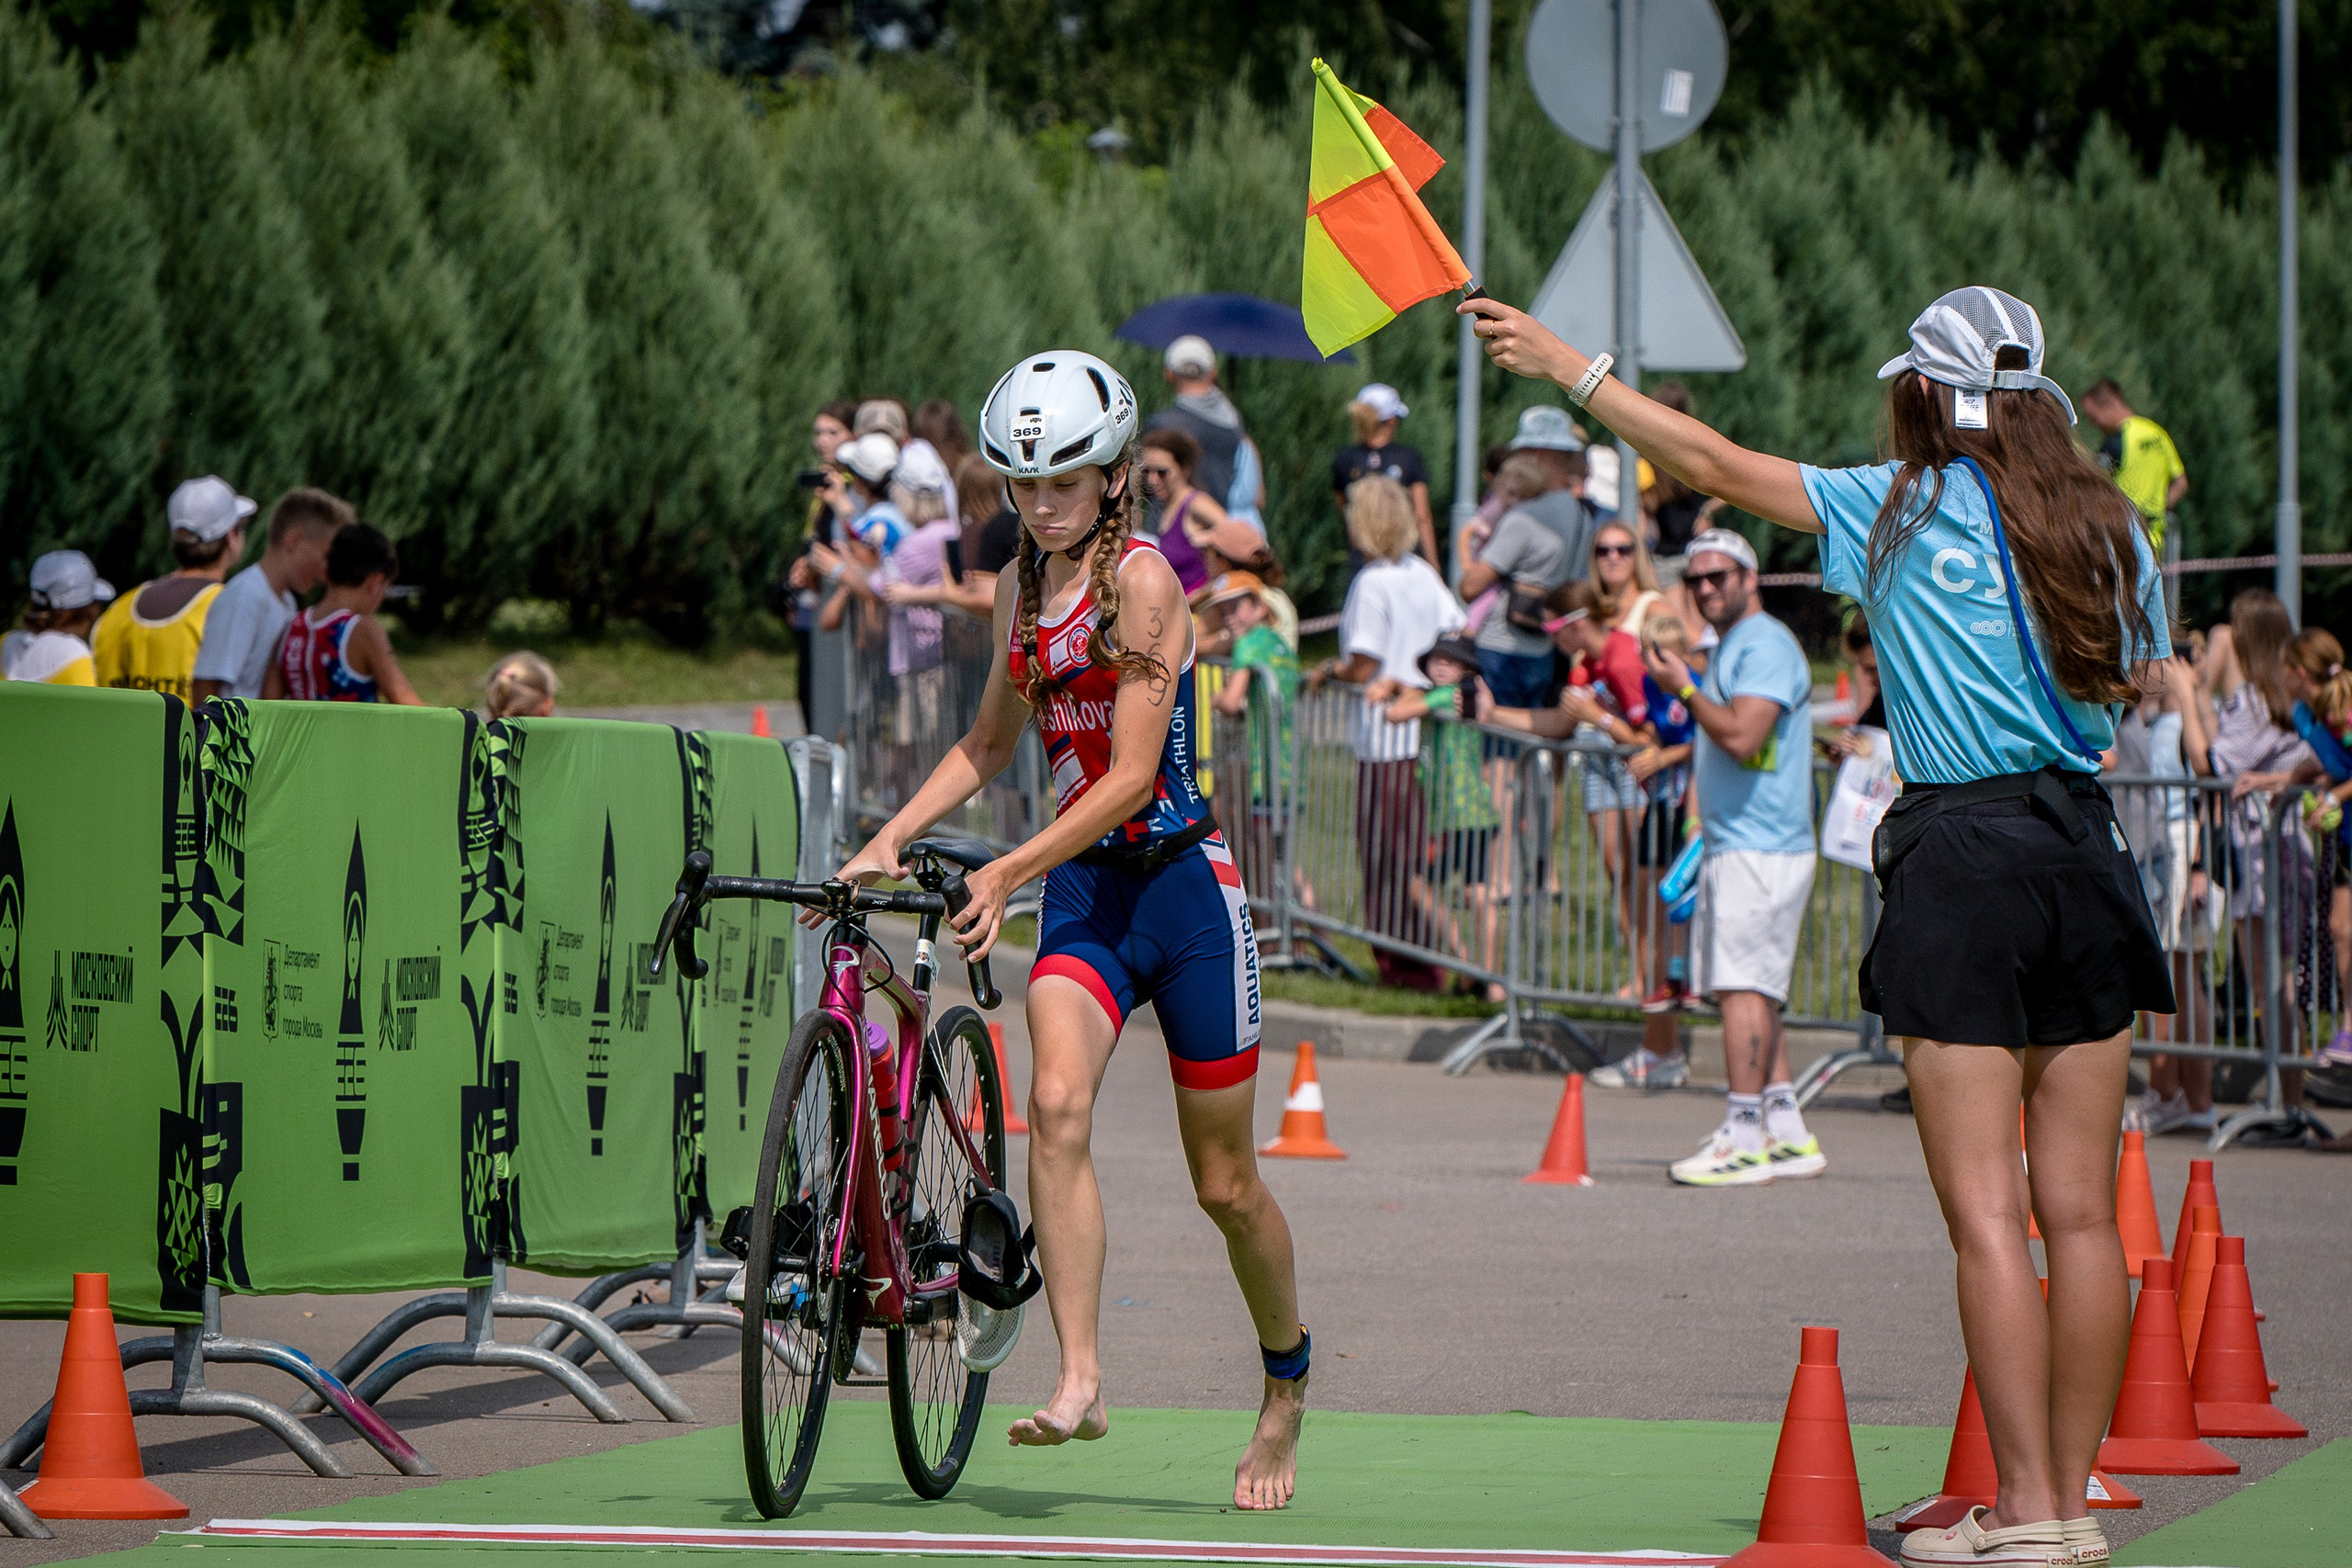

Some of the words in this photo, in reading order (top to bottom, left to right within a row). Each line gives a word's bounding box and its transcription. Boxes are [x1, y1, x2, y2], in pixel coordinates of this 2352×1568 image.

[1114, 407, 1129, 424] 369
[1012, 426, 1042, 438] 369
[1170, 705, 1199, 805] TRIATHLON
[283, 943, 321, 973] Департамент
[1238, 902, 1261, 1026] AQUATICS
[72, 945, 134, 1005] МОСКОВСКИЙ
[283, 984, 303, 1007] спорта
[71, 1004, 100, 1053] СПОРТ
[302, 1015, 323, 1039] Москвы
[2081, 1547, 2109, 1559] crocs
